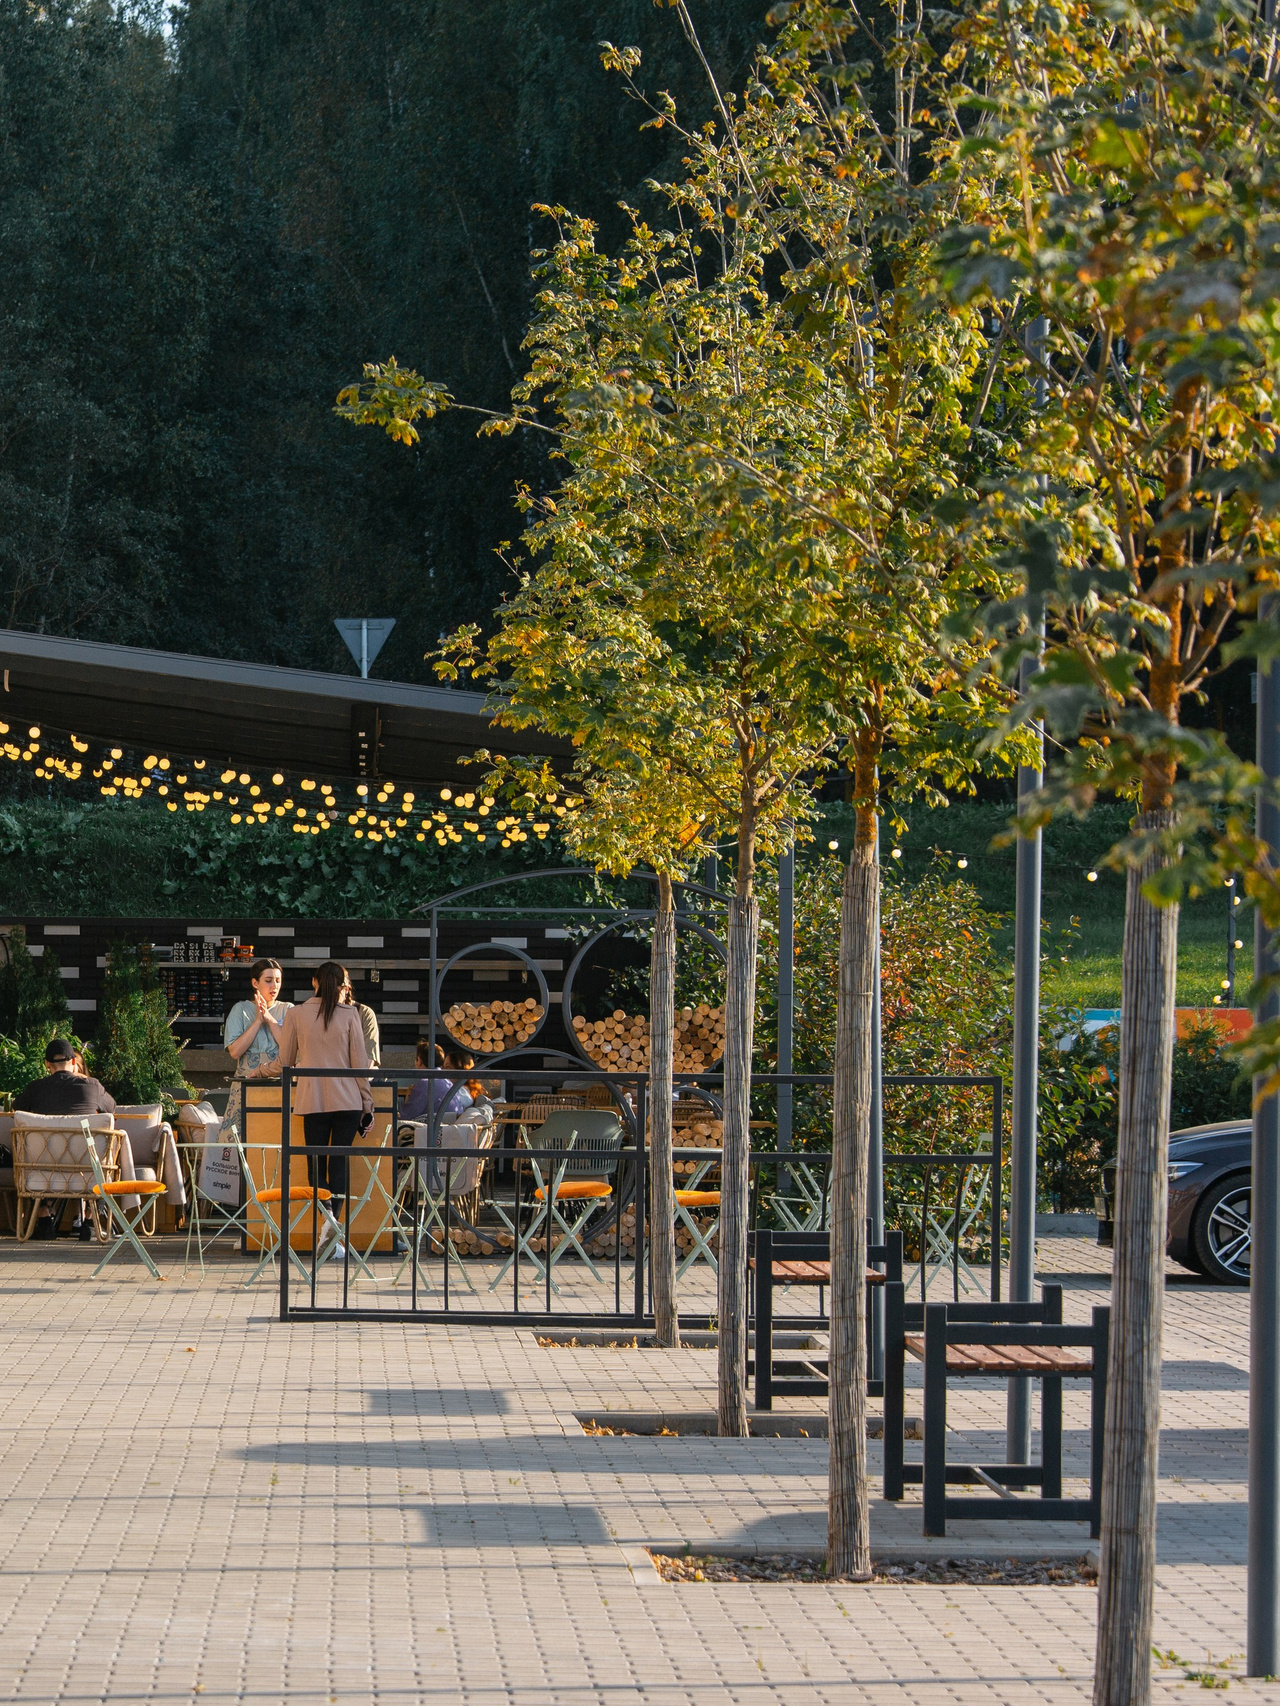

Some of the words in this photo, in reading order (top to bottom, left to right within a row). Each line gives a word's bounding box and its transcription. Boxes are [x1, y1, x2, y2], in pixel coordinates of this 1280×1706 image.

[205, 1165, 228, 1175] РУССКОЕ
[212, 1161, 238, 1171] БОЛЬШОЕ
[212, 1180, 232, 1190] simple
